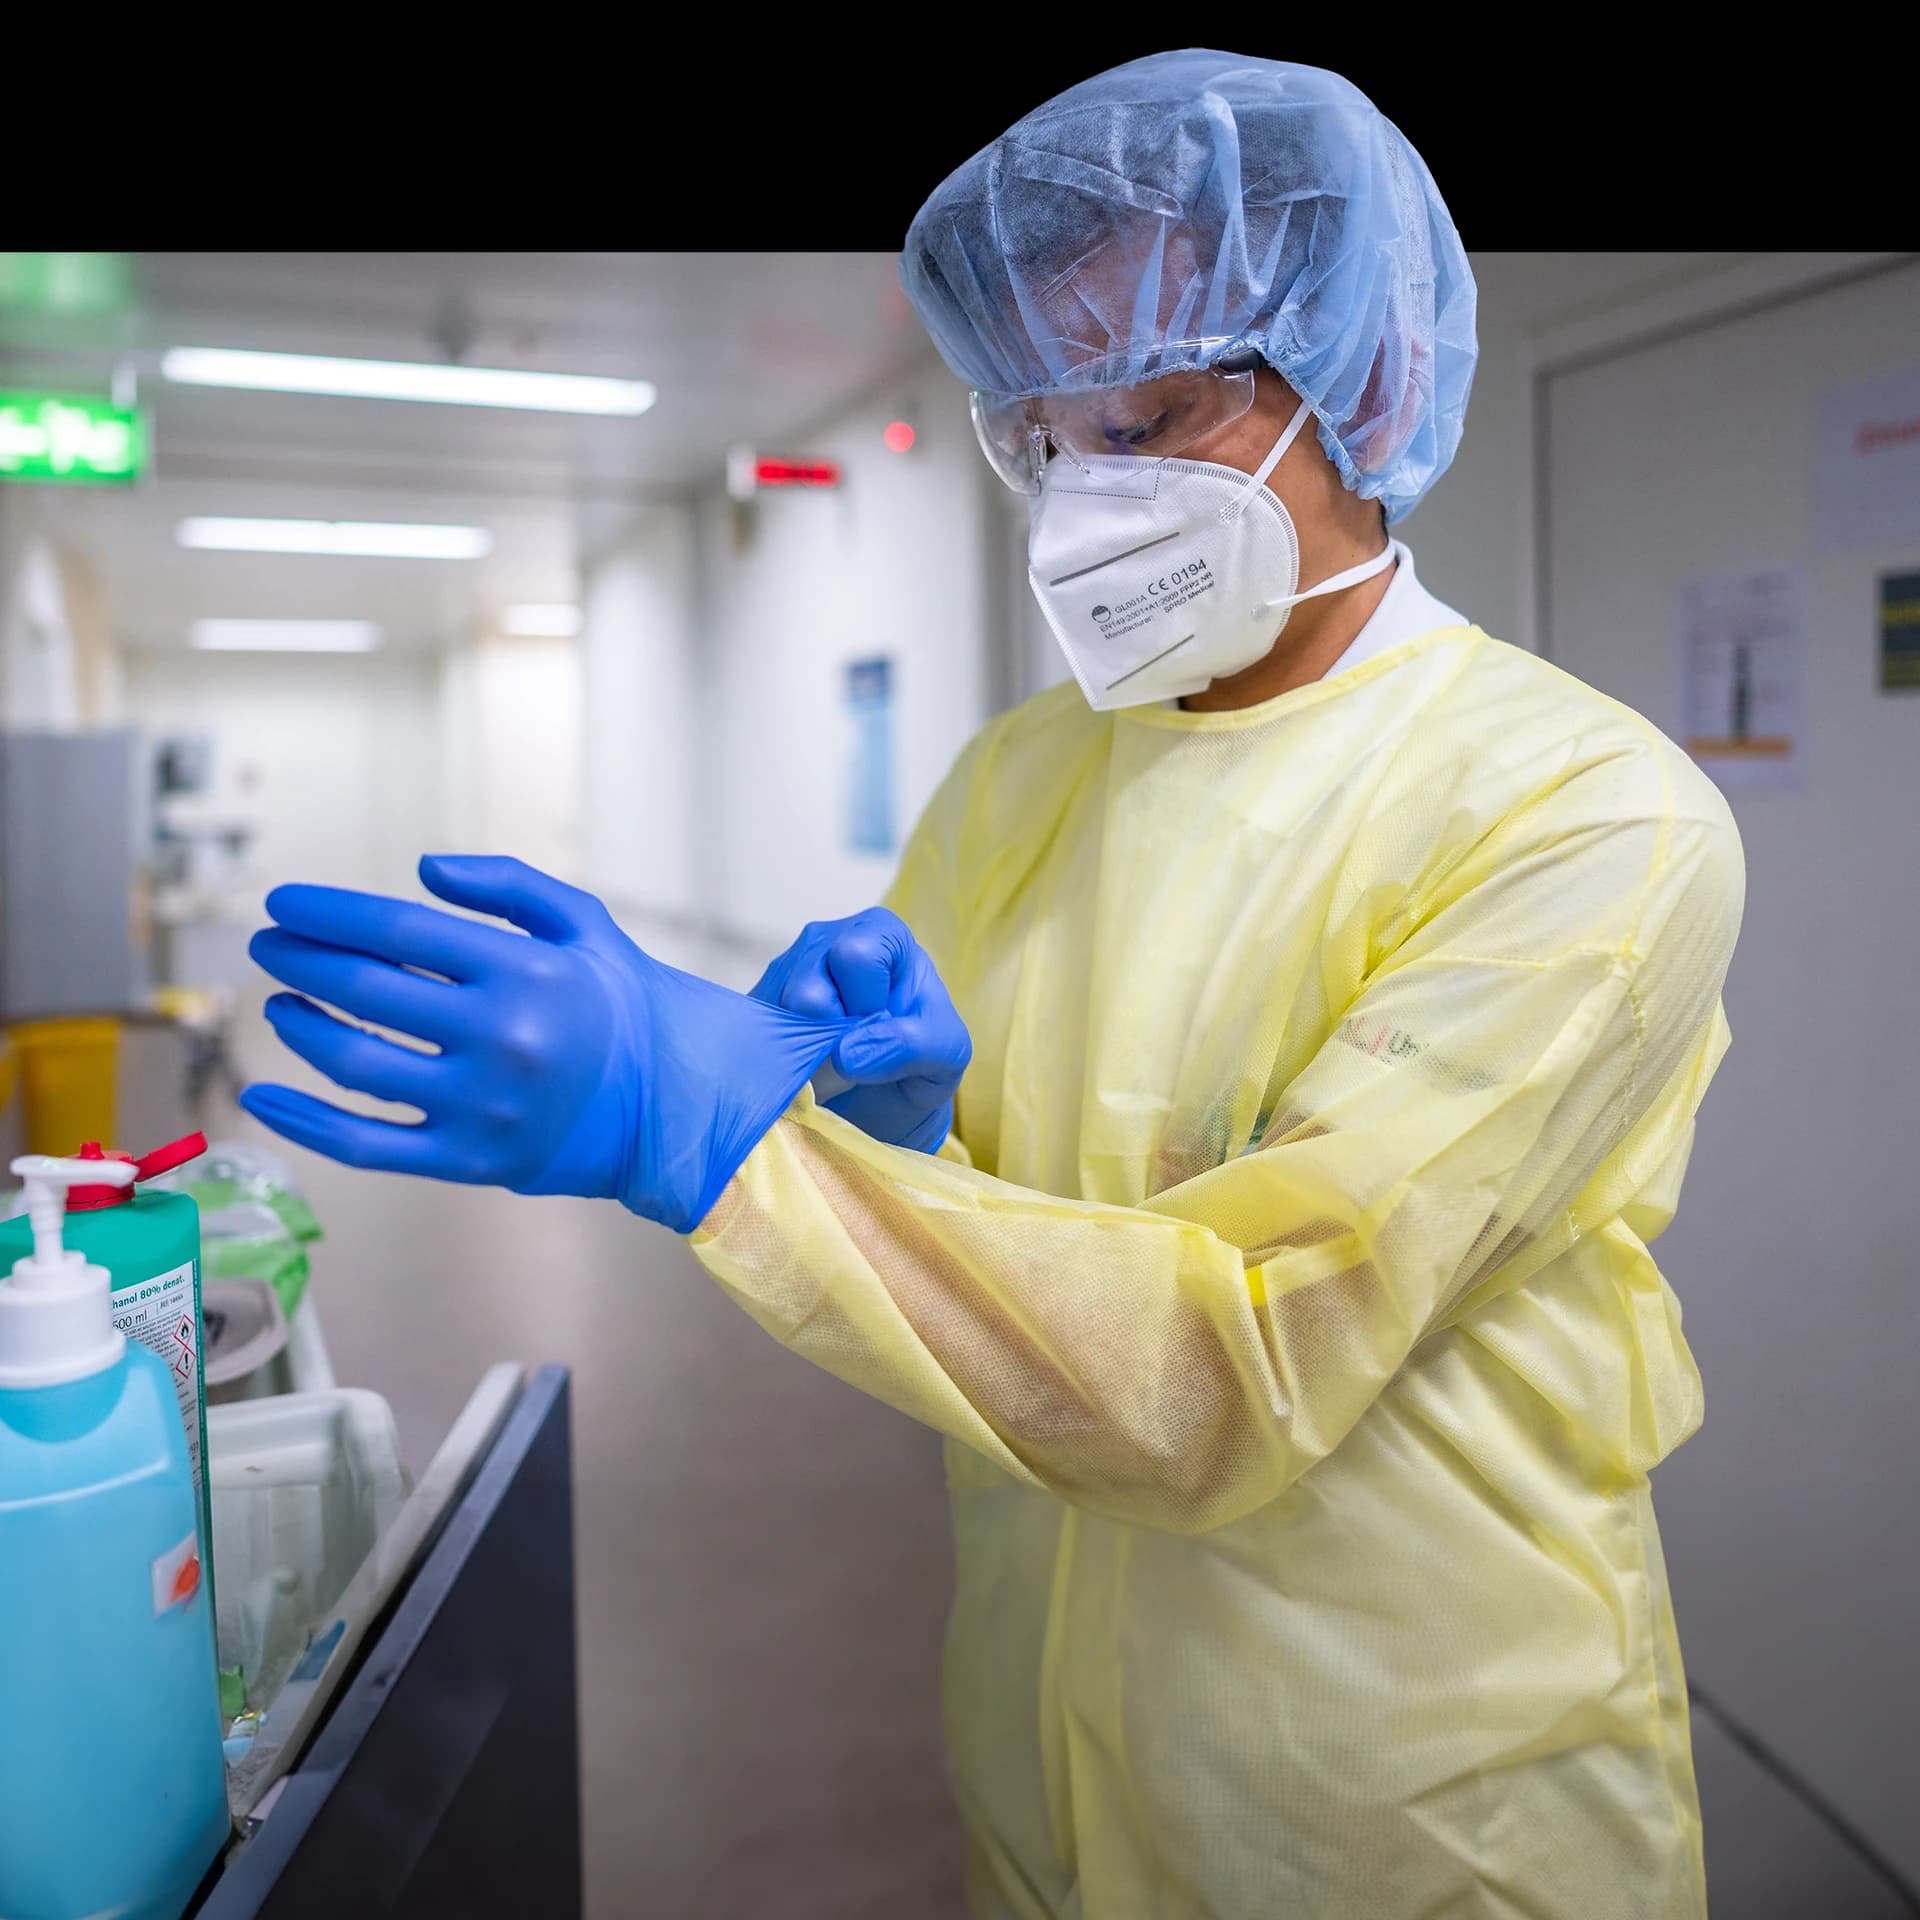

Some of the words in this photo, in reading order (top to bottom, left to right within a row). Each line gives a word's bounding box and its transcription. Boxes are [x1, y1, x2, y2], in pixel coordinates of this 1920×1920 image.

[1147, 577, 1169, 595] CE
[1170, 558, 1206, 585] 0194
[1180, 579, 1199, 594] FFP2
[139, 1284, 161, 1300] 80%
[135, 1309, 147, 1324] ml
